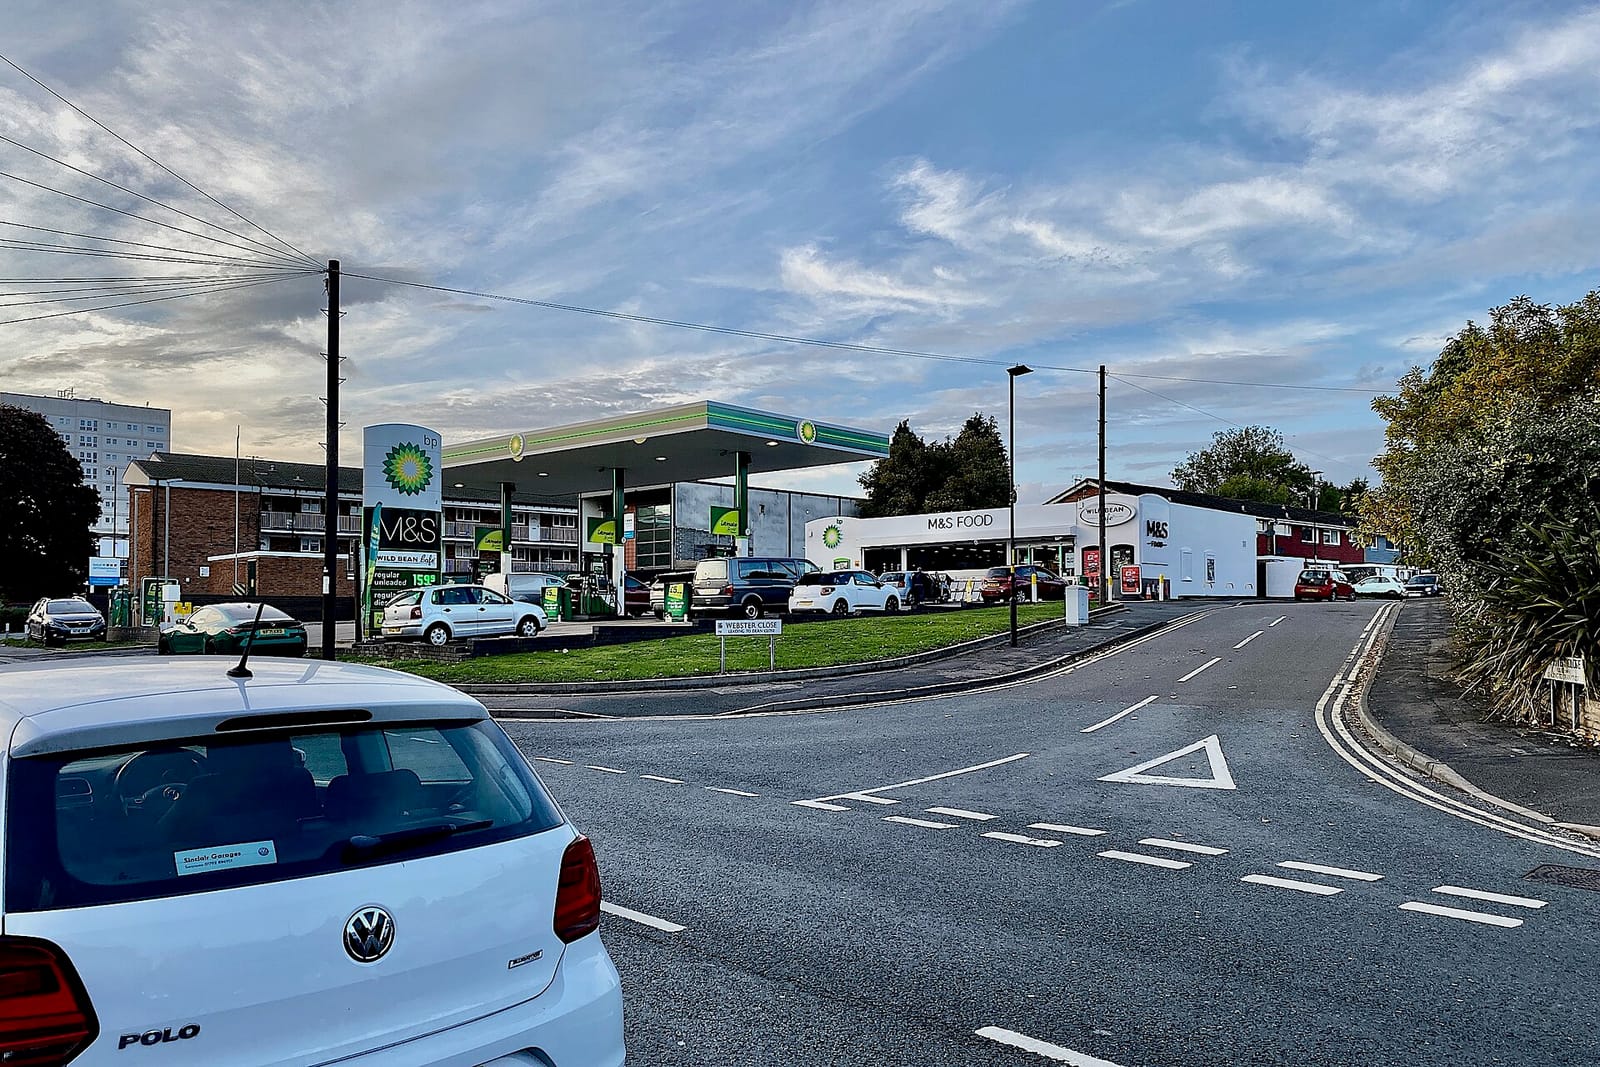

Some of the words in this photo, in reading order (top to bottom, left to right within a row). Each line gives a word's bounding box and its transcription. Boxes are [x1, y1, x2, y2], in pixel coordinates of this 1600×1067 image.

[424, 434, 438, 449] bp
[380, 516, 436, 544] M&S
[928, 517, 953, 530] M&S
[956, 514, 993, 528] FOOD
[1146, 519, 1168, 539] M&S
[374, 571, 400, 579] regular
[183, 855, 209, 864] Sinclair
[210, 851, 242, 860] Garages
[118, 1023, 201, 1050] POLO
